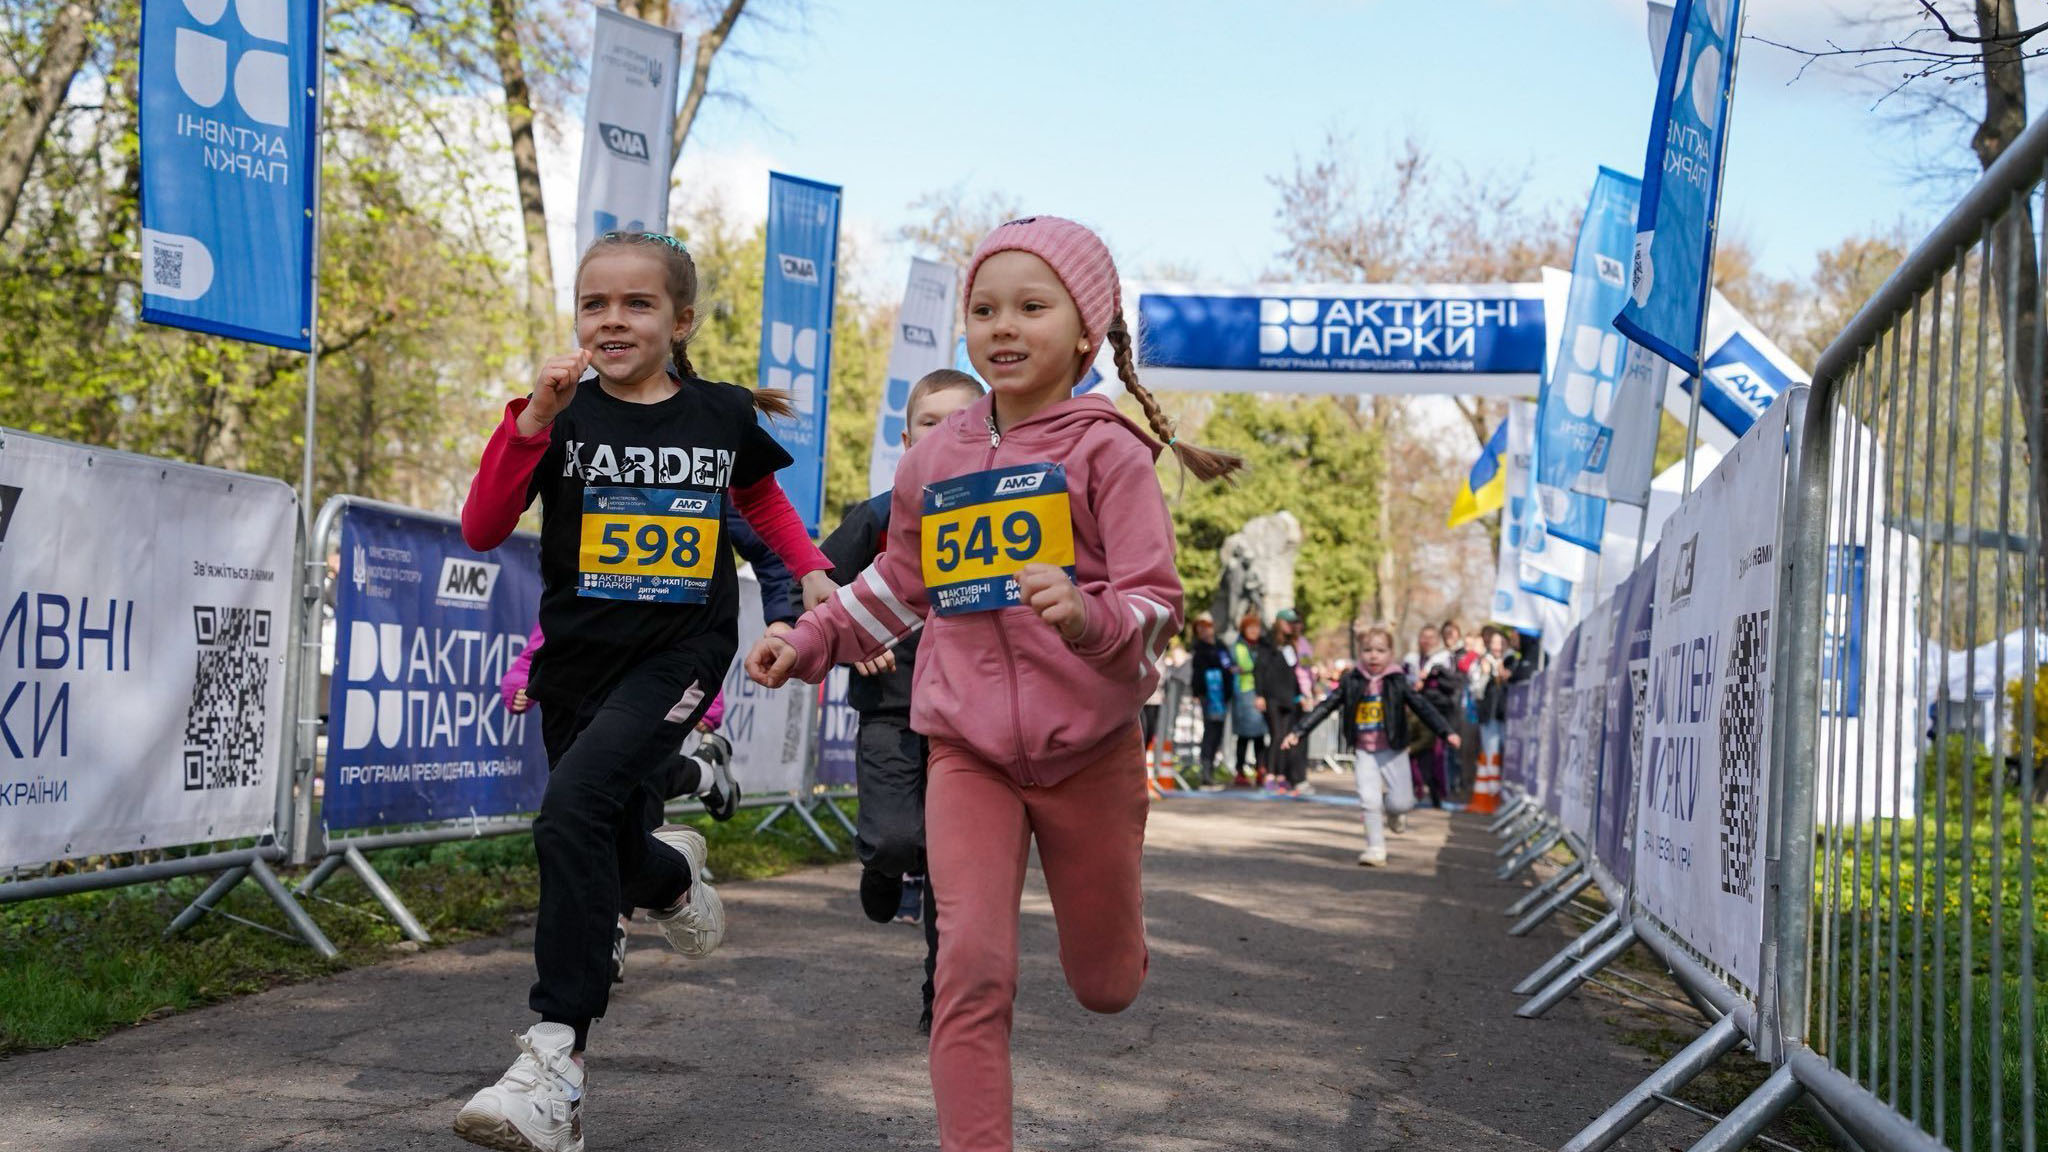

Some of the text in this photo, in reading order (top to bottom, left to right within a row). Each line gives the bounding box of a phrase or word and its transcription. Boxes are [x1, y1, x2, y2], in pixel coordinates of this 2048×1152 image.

[1323, 299, 1518, 328] АКТИВНІ
[1322, 326, 1476, 357] ПАРКИ
[562, 439, 737, 488] KARDEN
[598, 523, 700, 569] 598
[936, 510, 1042, 573] 549
[193, 560, 249, 580] Зв'яжіться
[598, 574, 642, 583] АКТИВНІ
[598, 580, 632, 590] ПАРКИ
[638, 586, 670, 595] ДИТЯЧИЙ
[662, 578, 680, 586] МХП
[949, 583, 991, 598] АКТИВНІ
[950, 594, 980, 607] ПАРКИ
[407, 690, 526, 748] ПАРКИ
